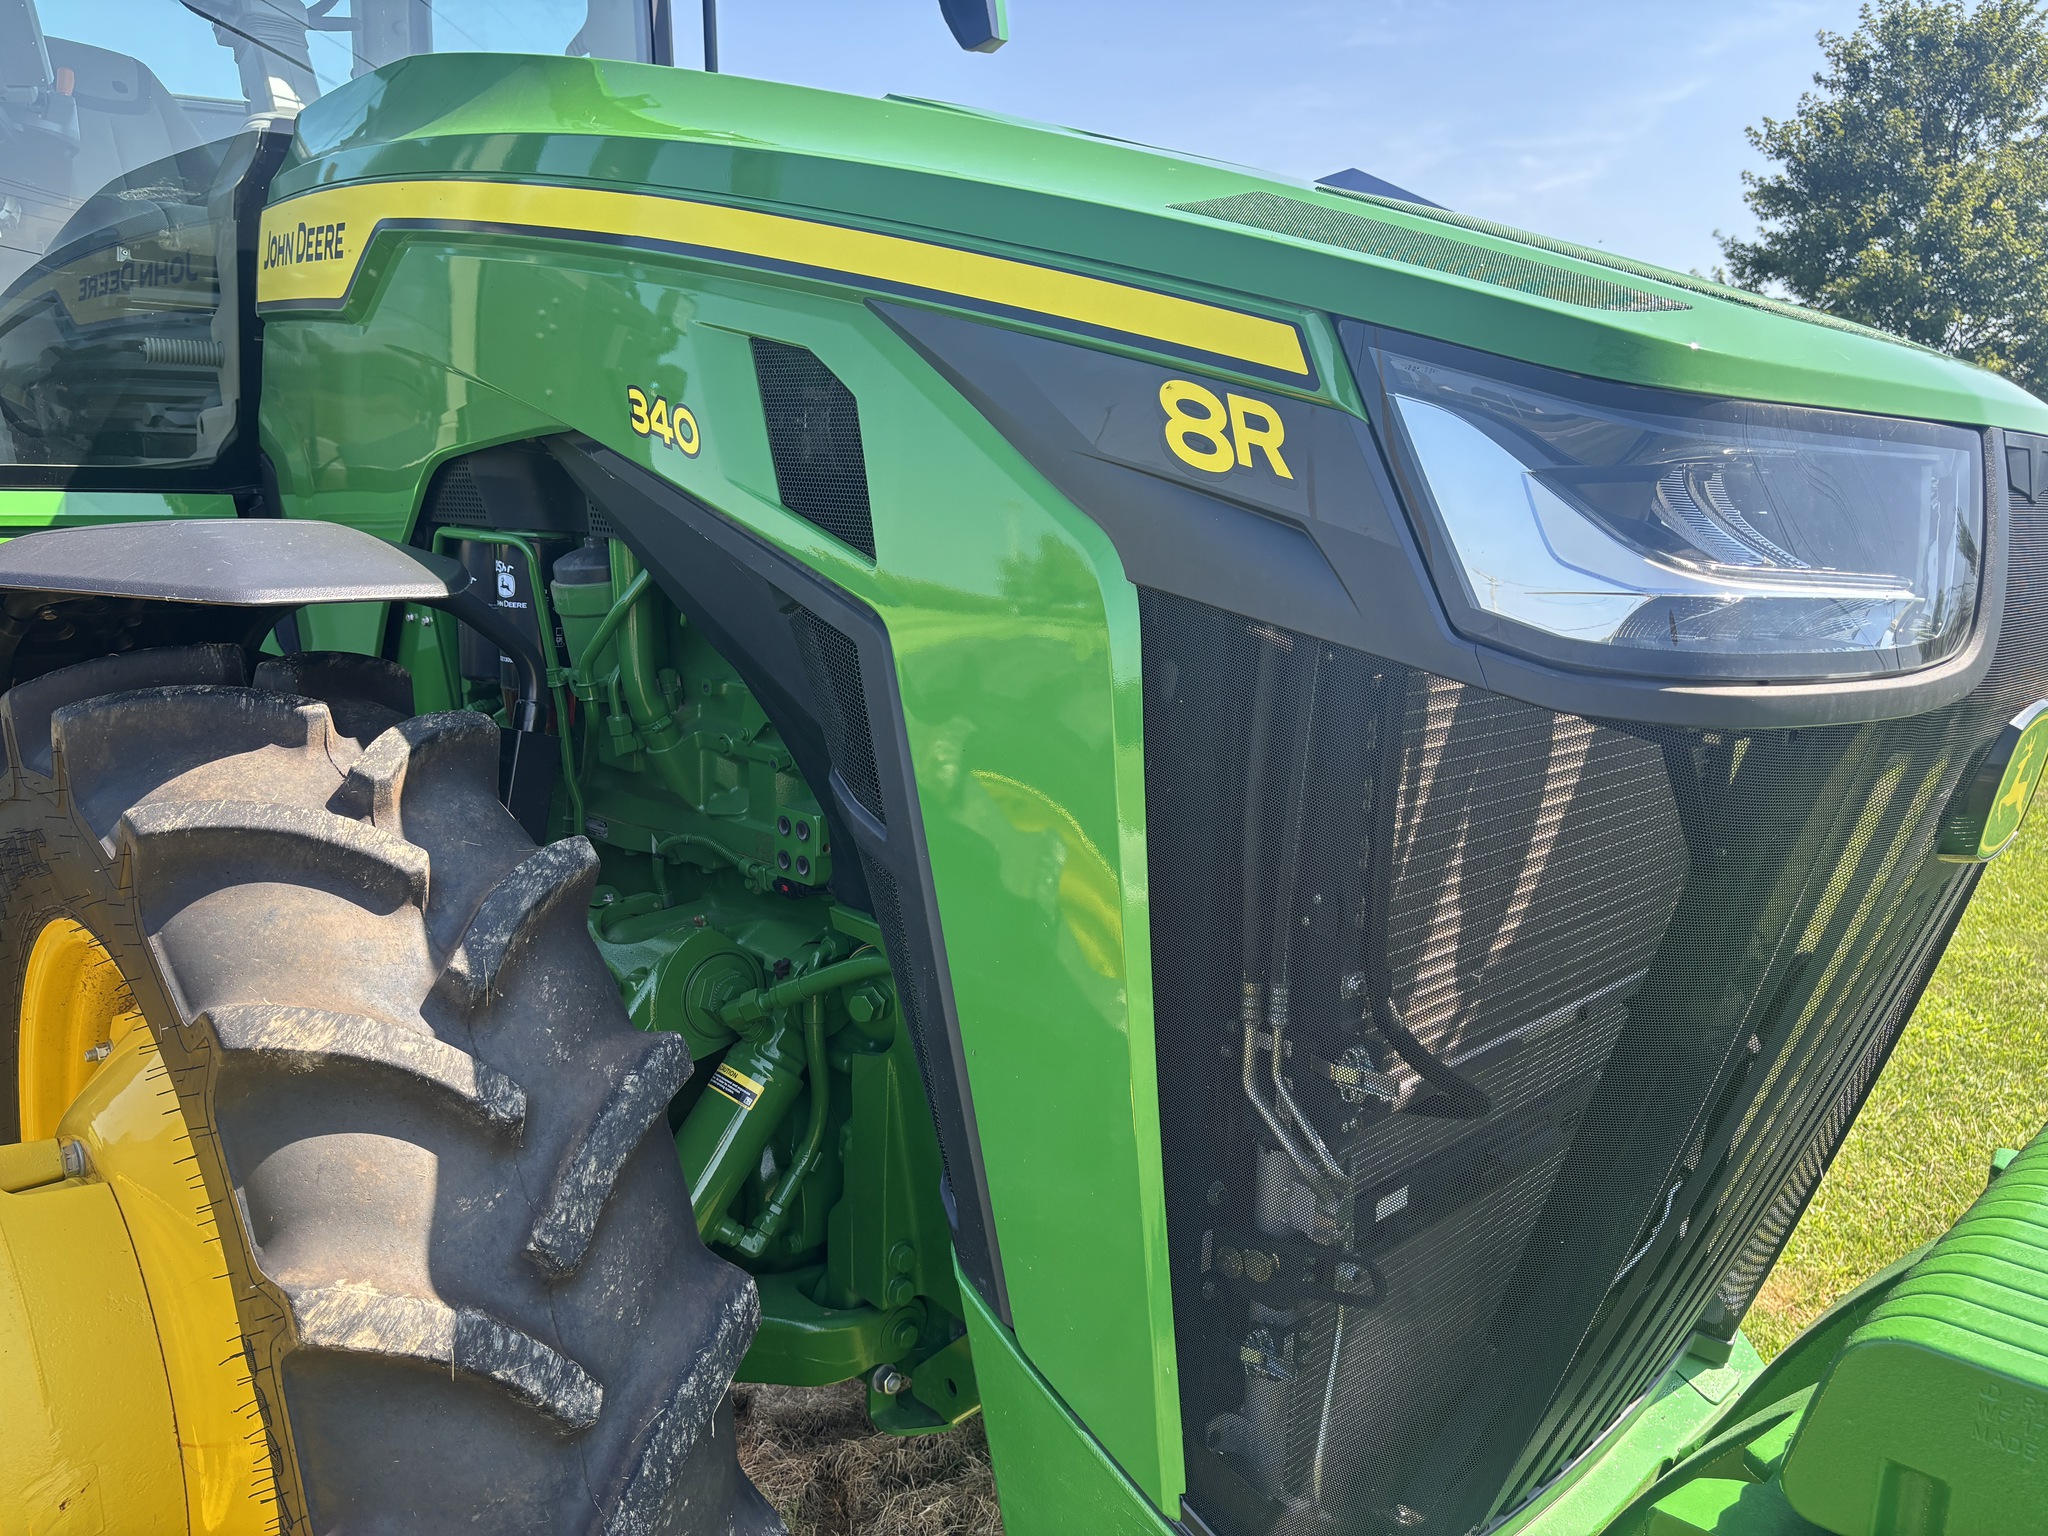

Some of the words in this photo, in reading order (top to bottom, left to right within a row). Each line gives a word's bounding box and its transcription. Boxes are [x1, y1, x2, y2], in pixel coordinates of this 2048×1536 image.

[263, 230, 295, 270] JOHN
[296, 222, 346, 265] DEERE
[627, 385, 701, 459] 340
[1159, 379, 1294, 480] 8R
[503, 600, 528, 609] DEERE
[720, 1064, 739, 1079] CAUTION
